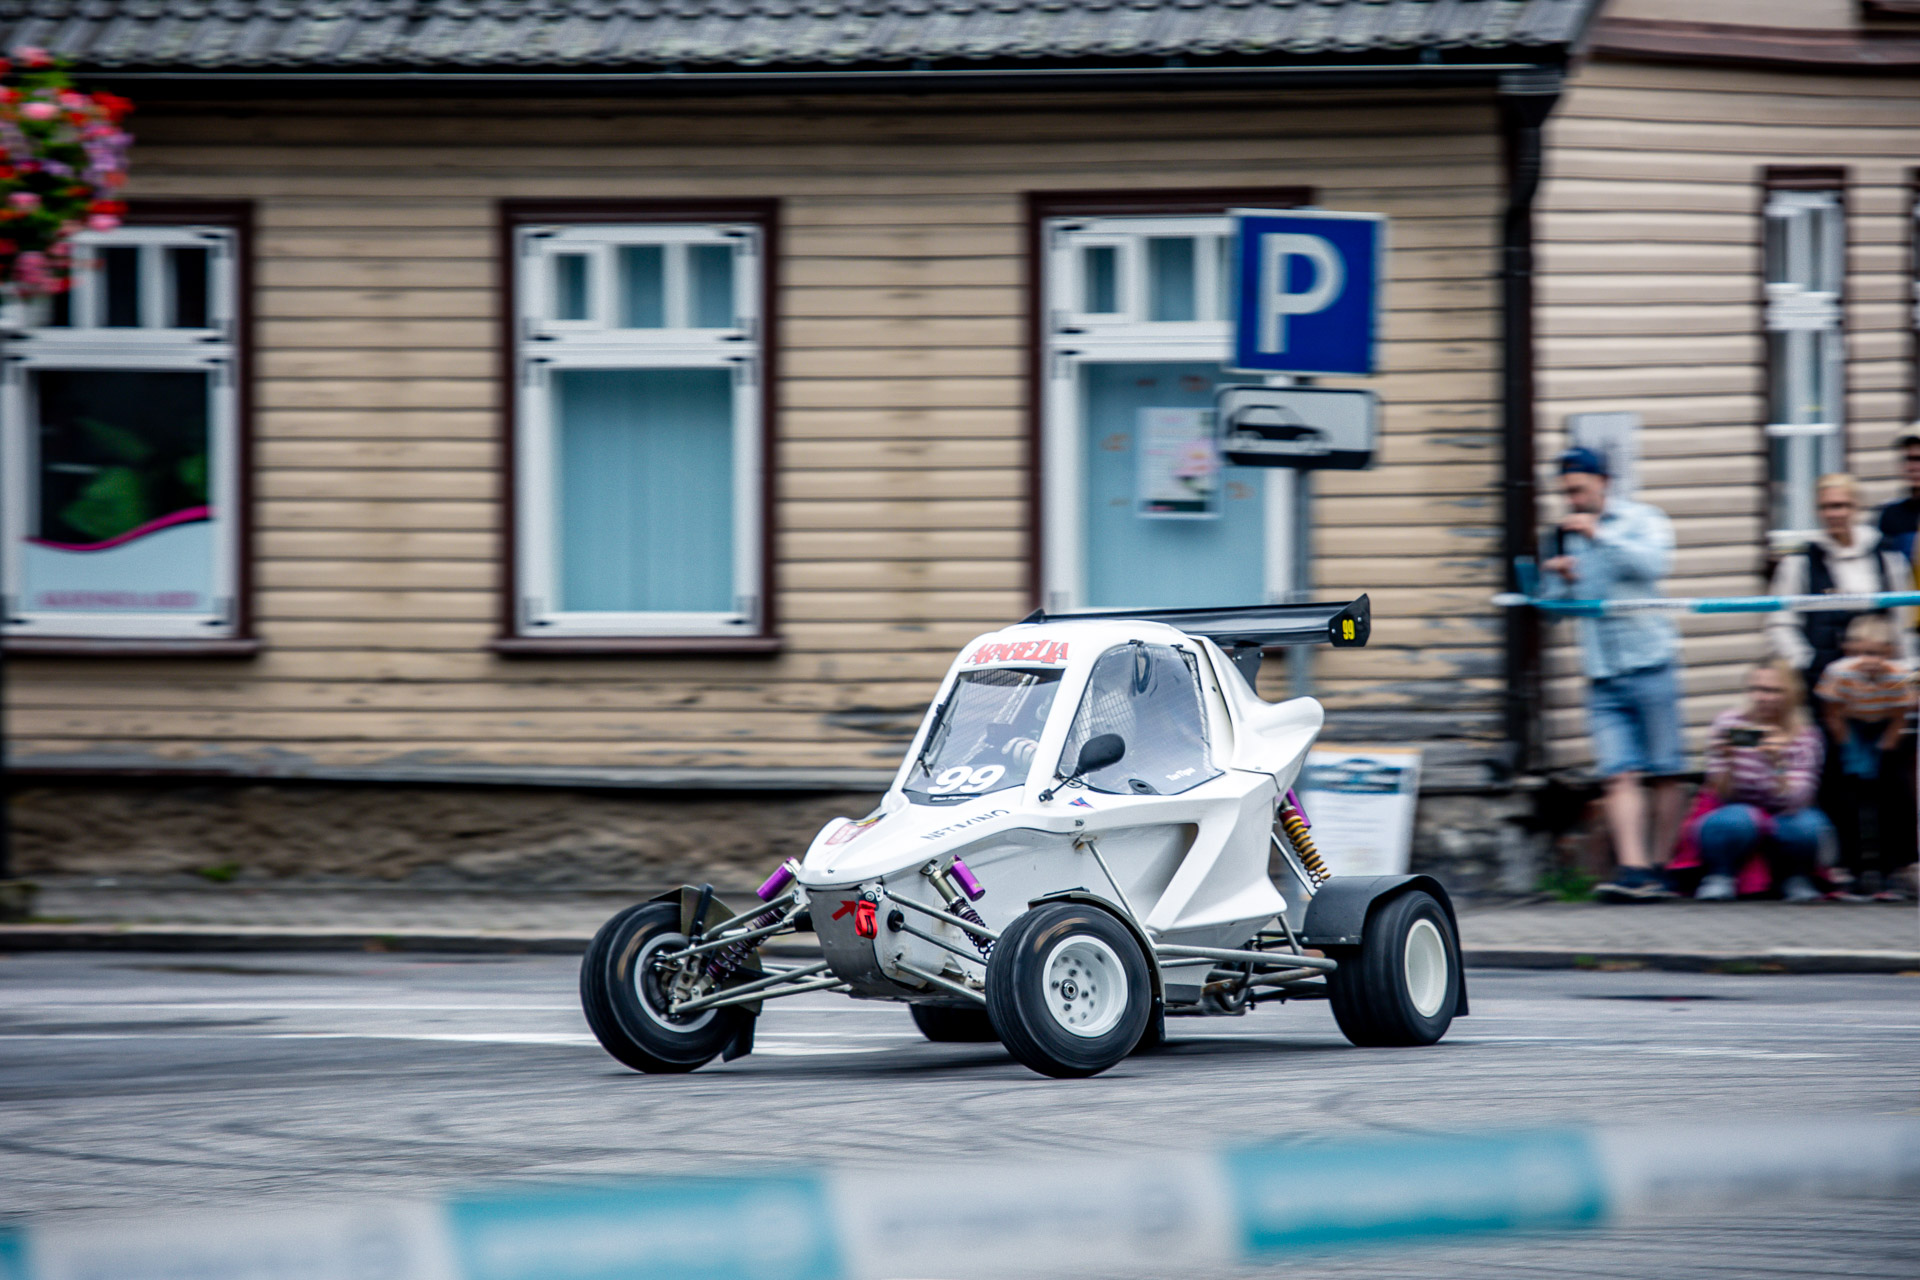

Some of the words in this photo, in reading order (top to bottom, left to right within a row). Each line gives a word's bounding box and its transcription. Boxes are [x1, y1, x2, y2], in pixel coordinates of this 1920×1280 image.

[1256, 231, 1347, 353] P
[1342, 619, 1355, 640] 99
[927, 765, 1005, 794] 99
